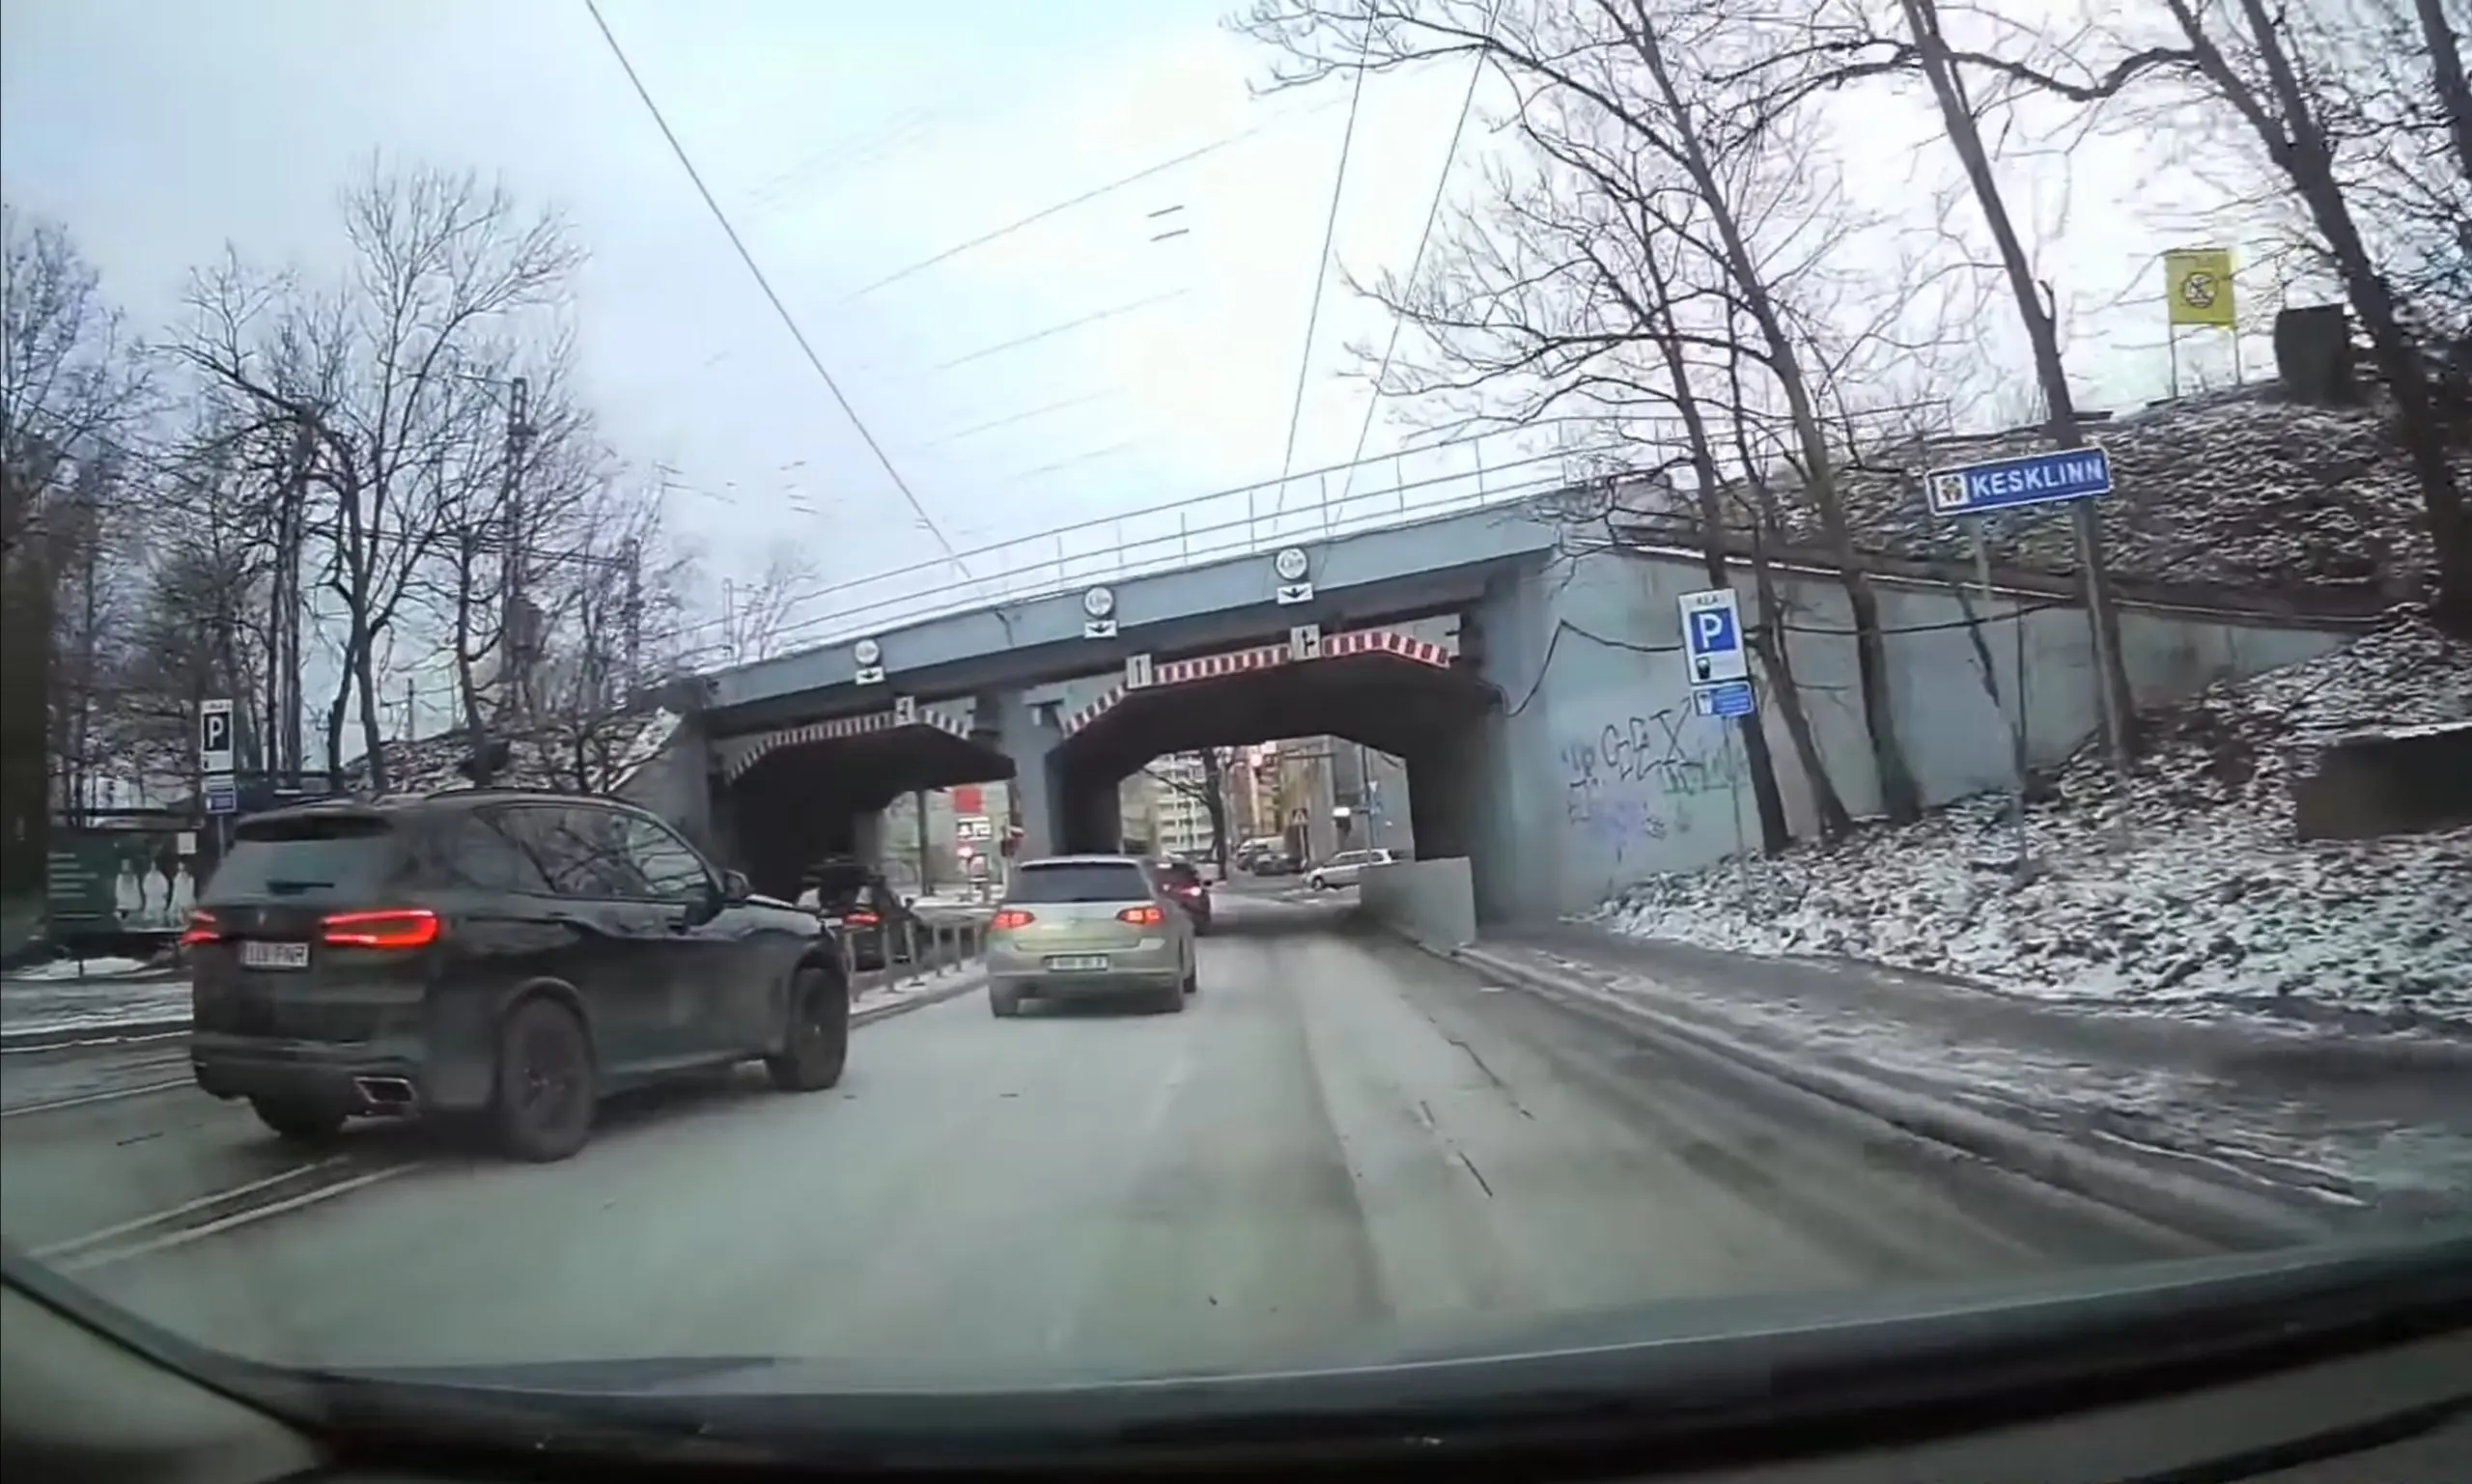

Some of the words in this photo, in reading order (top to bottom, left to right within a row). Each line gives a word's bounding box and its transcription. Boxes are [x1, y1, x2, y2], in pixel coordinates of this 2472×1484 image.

[1971, 459, 2103, 498] KESKLINN
[1699, 613, 1723, 649] P
[209, 716, 224, 747] P
